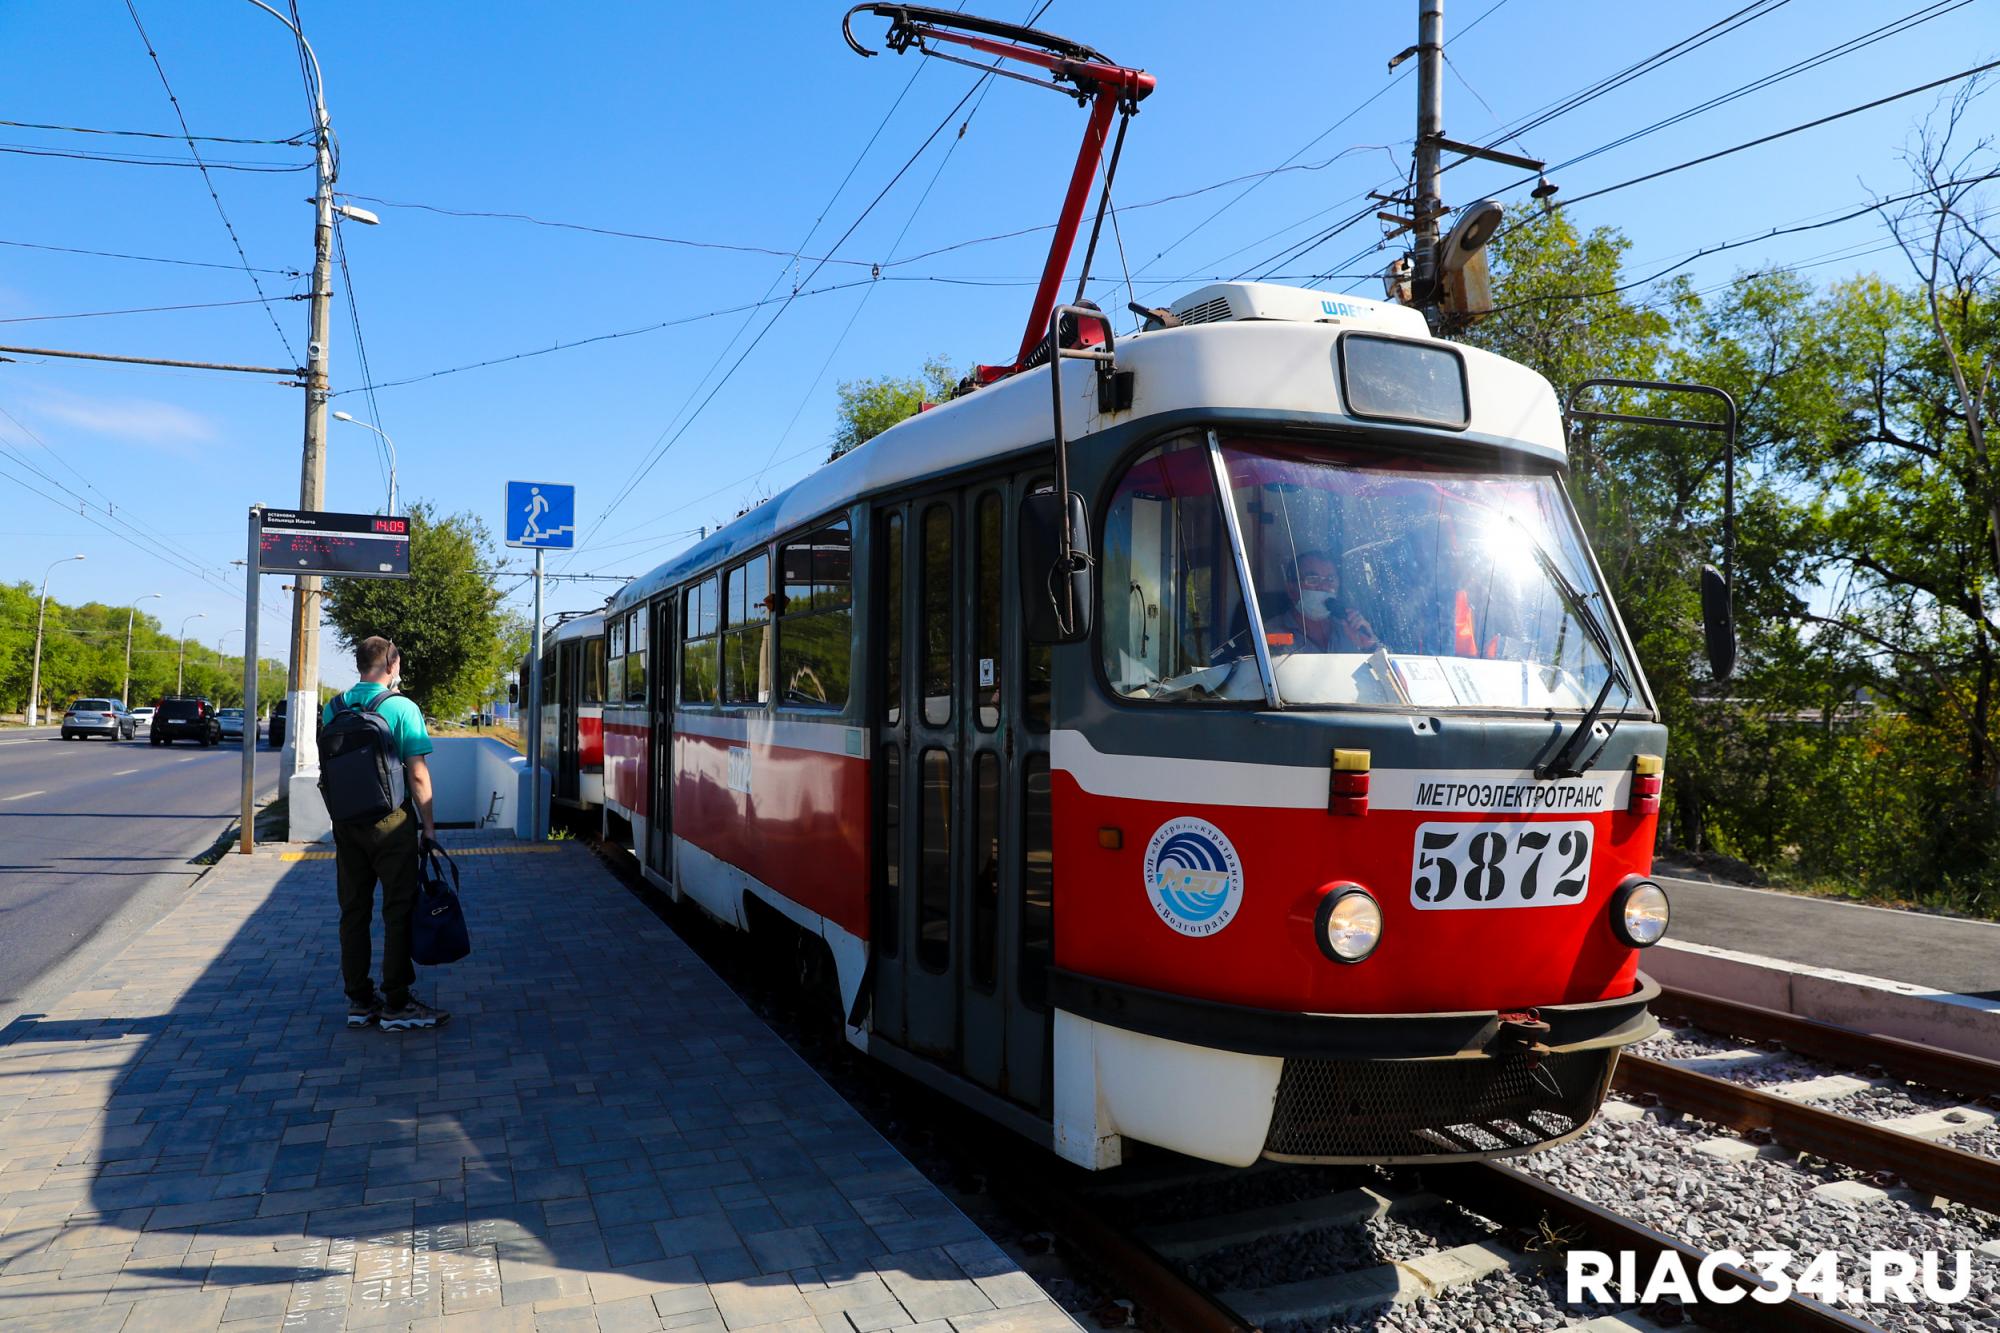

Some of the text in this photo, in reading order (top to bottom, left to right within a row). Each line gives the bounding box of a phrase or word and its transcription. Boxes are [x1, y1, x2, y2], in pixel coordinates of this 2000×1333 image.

[1416, 783, 1604, 808] МЕТРОЭЛЕКТРОТРАНС
[1414, 830, 1589, 903] 5872
[1162, 909, 1230, 934] Волгограда
